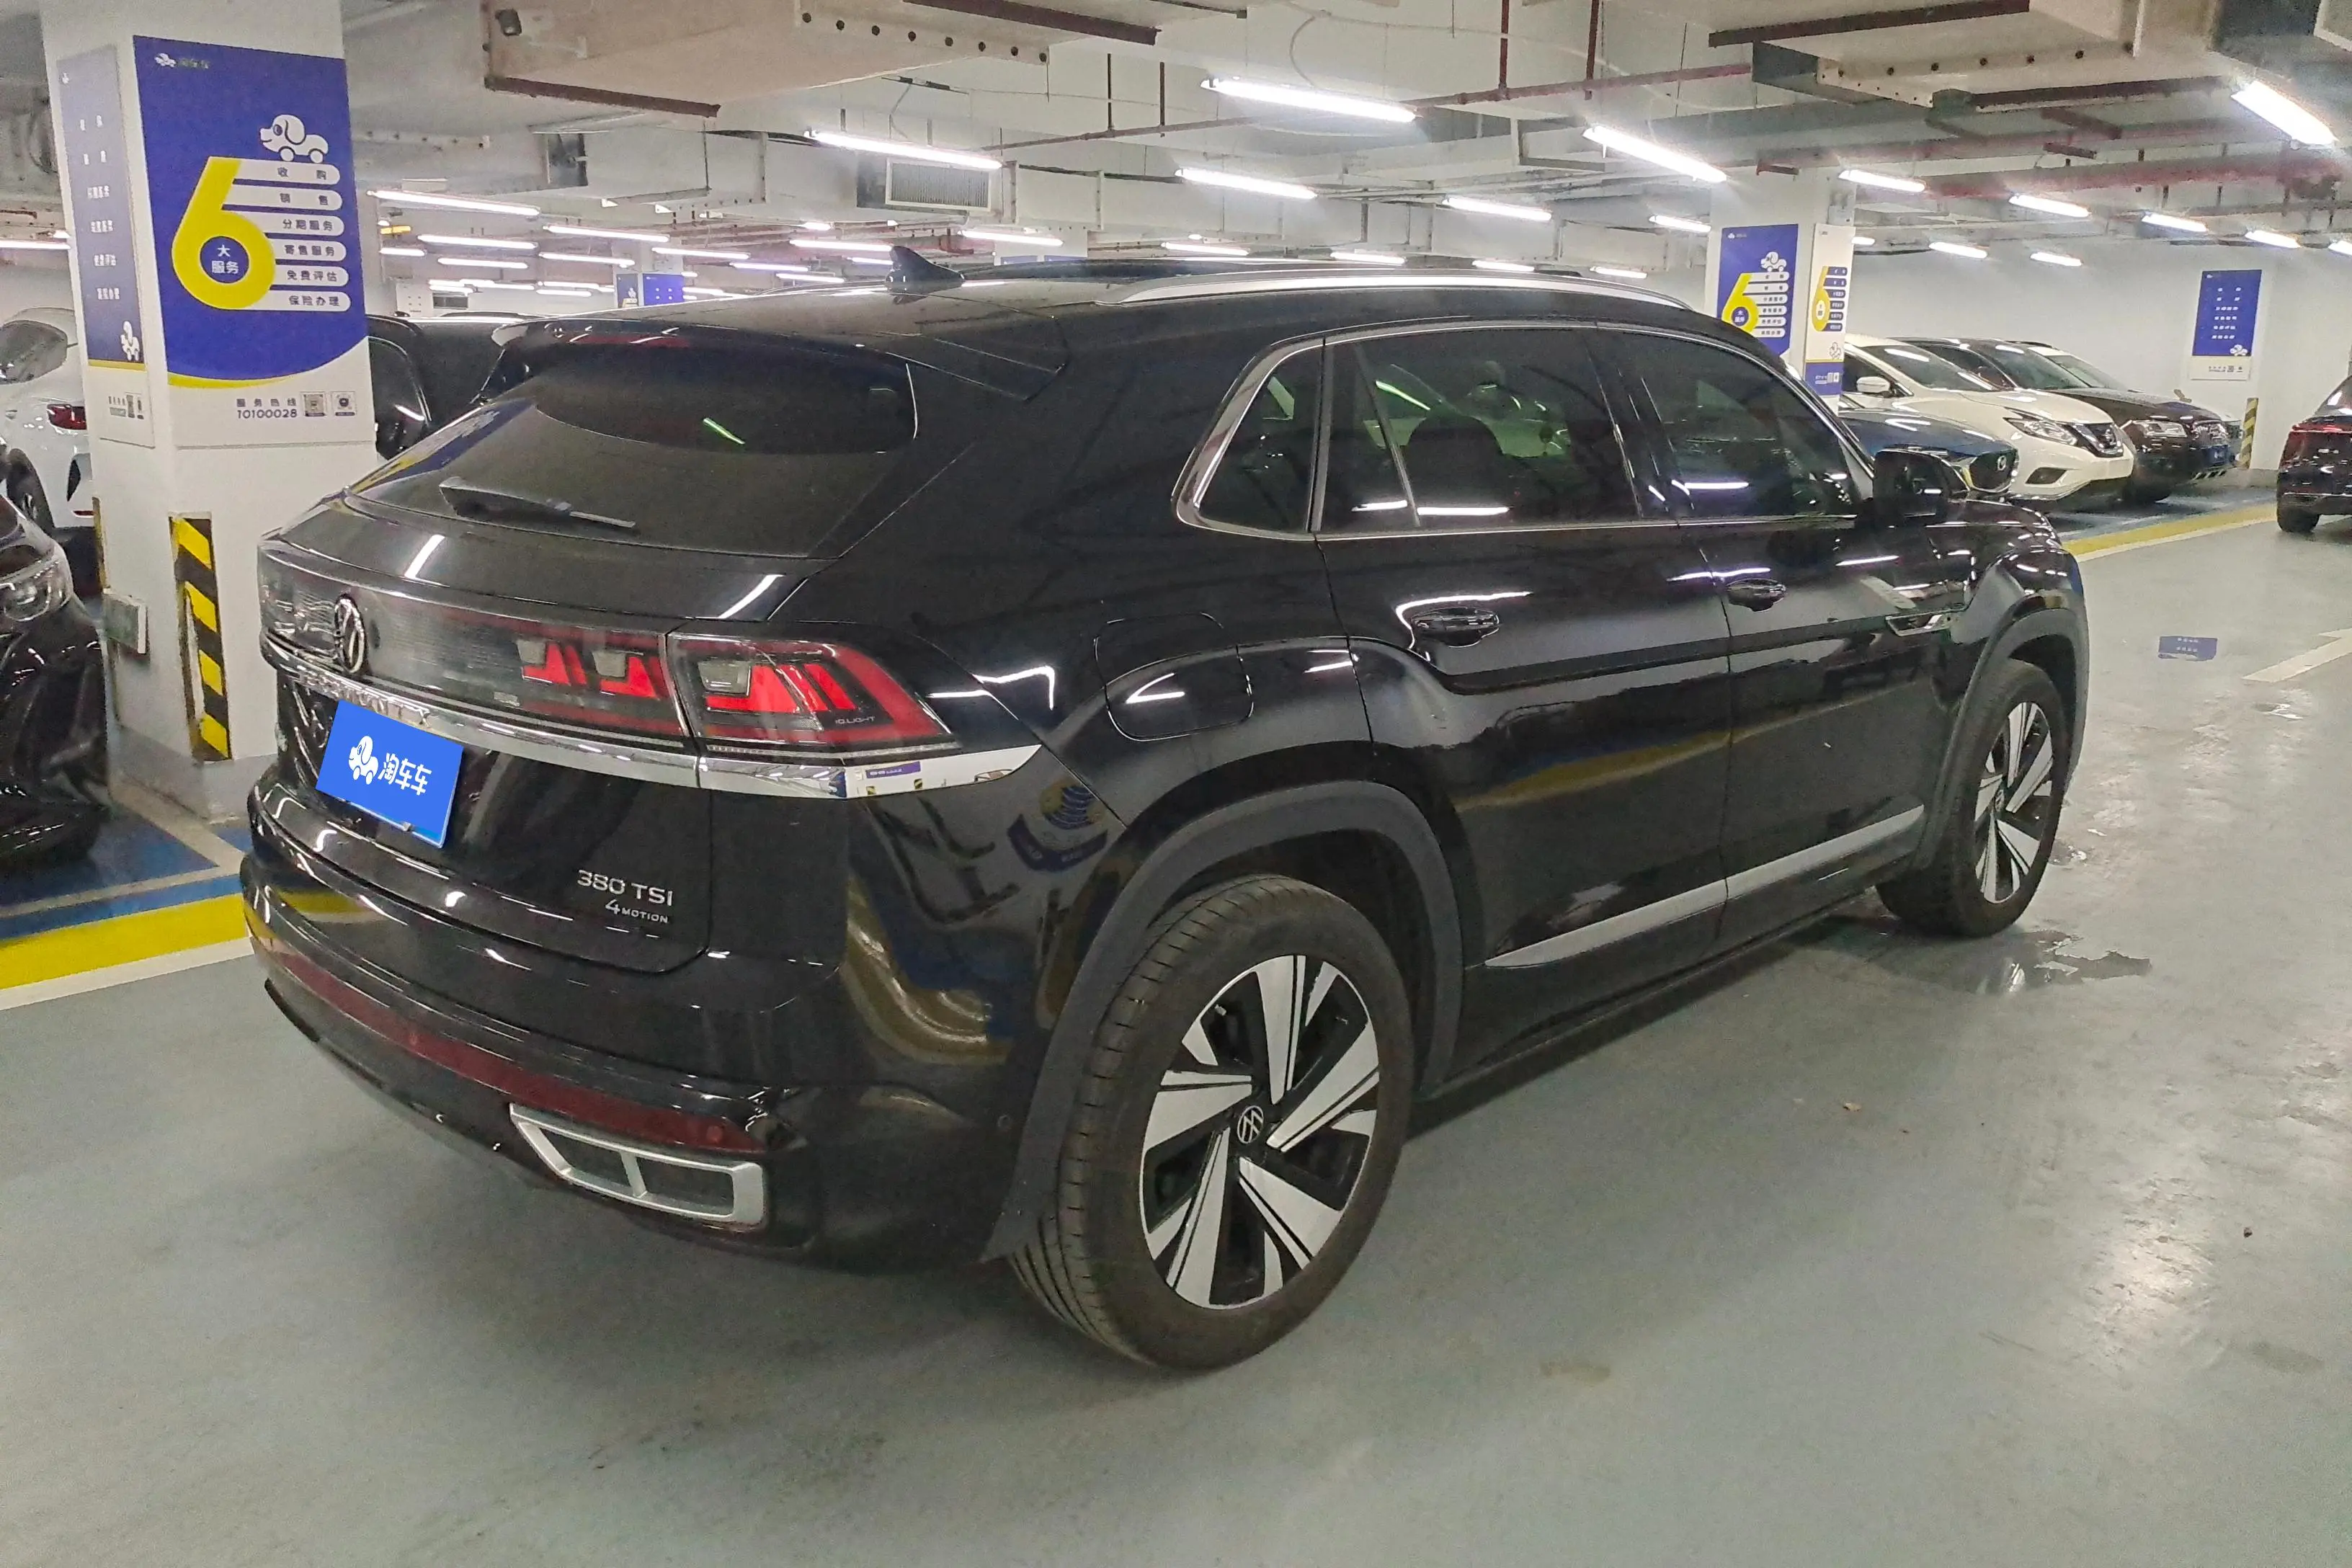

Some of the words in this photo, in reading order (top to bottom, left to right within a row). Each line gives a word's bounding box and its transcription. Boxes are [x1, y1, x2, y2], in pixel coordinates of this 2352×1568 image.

[172, 156, 275, 310] 6
[217, 245, 231, 257] 大
[211, 260, 239, 275] 服务
[289, 295, 340, 306] 保险办理
[237, 409, 298, 419] 10100028
[577, 869, 625, 895] 380
[631, 883, 673, 906] TSI
[605, 899, 668, 923] 4MOTION
